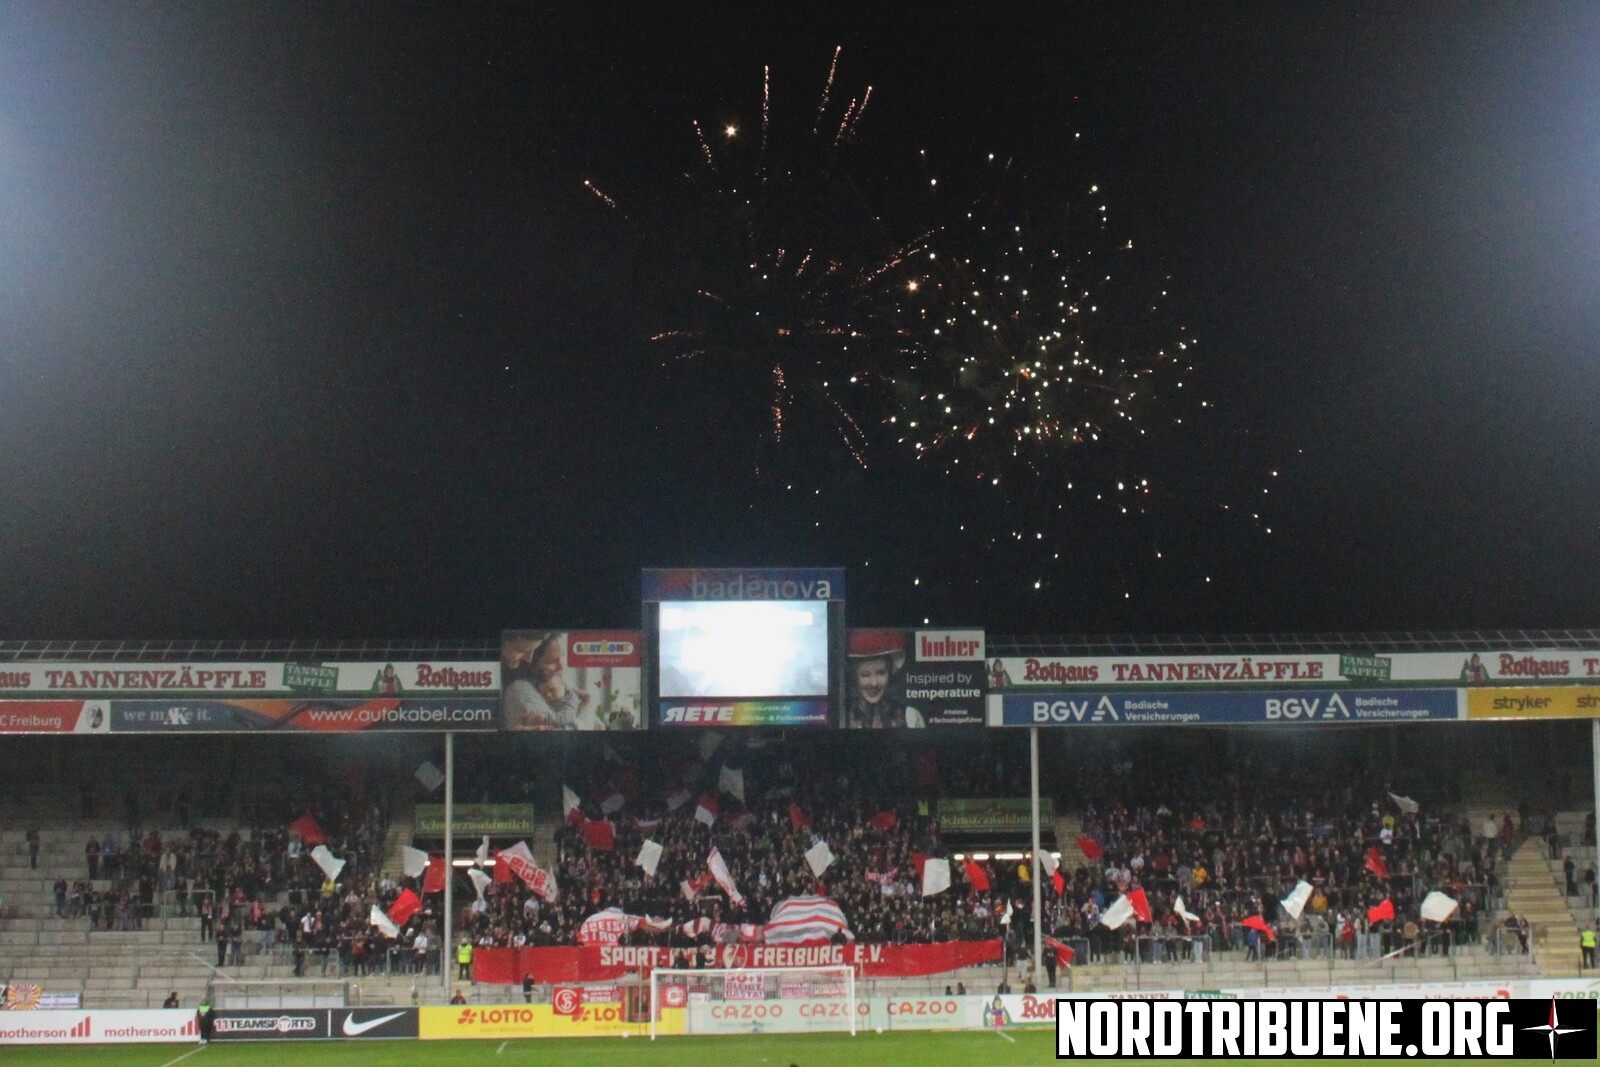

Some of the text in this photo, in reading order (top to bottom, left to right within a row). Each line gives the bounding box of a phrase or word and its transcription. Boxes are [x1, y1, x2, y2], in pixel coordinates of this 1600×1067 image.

[692, 574, 831, 599] badenova
[921, 636, 980, 658] huber
[1023, 659, 1324, 684] Rothaus TANNENZÄPFLE
[1498, 653, 1570, 680] Rothaus
[45, 666, 267, 689] TANNENZÄPFLE
[415, 664, 492, 690] Rothaus
[906, 673, 973, 686] Inspired by
[906, 689, 981, 701] temperature
[1355, 697, 1399, 707] Badische
[1577, 694, 1600, 709] str
[1124, 700, 1169, 710] Badische
[1265, 699, 1320, 720] BGV
[1492, 696, 1552, 711] stryker
[123, 711, 146, 721] we
[309, 706, 492, 723] www.autokabel.com
[1033, 701, 1089, 722] BGV
[1124, 712, 1201, 723] Versicherungen
[1355, 708, 1430, 719] Versicherungen
[10, 714, 62, 729] Freiburg
[753, 945, 844, 967] FREIBURG
[711, 1004, 783, 1019] CAZOO
[799, 1002, 871, 1018] CAZOO
[887, 1000, 958, 1017] CAZOO
[480, 1009, 533, 1024] LOTTO
[104, 1024, 176, 1037] motherson
